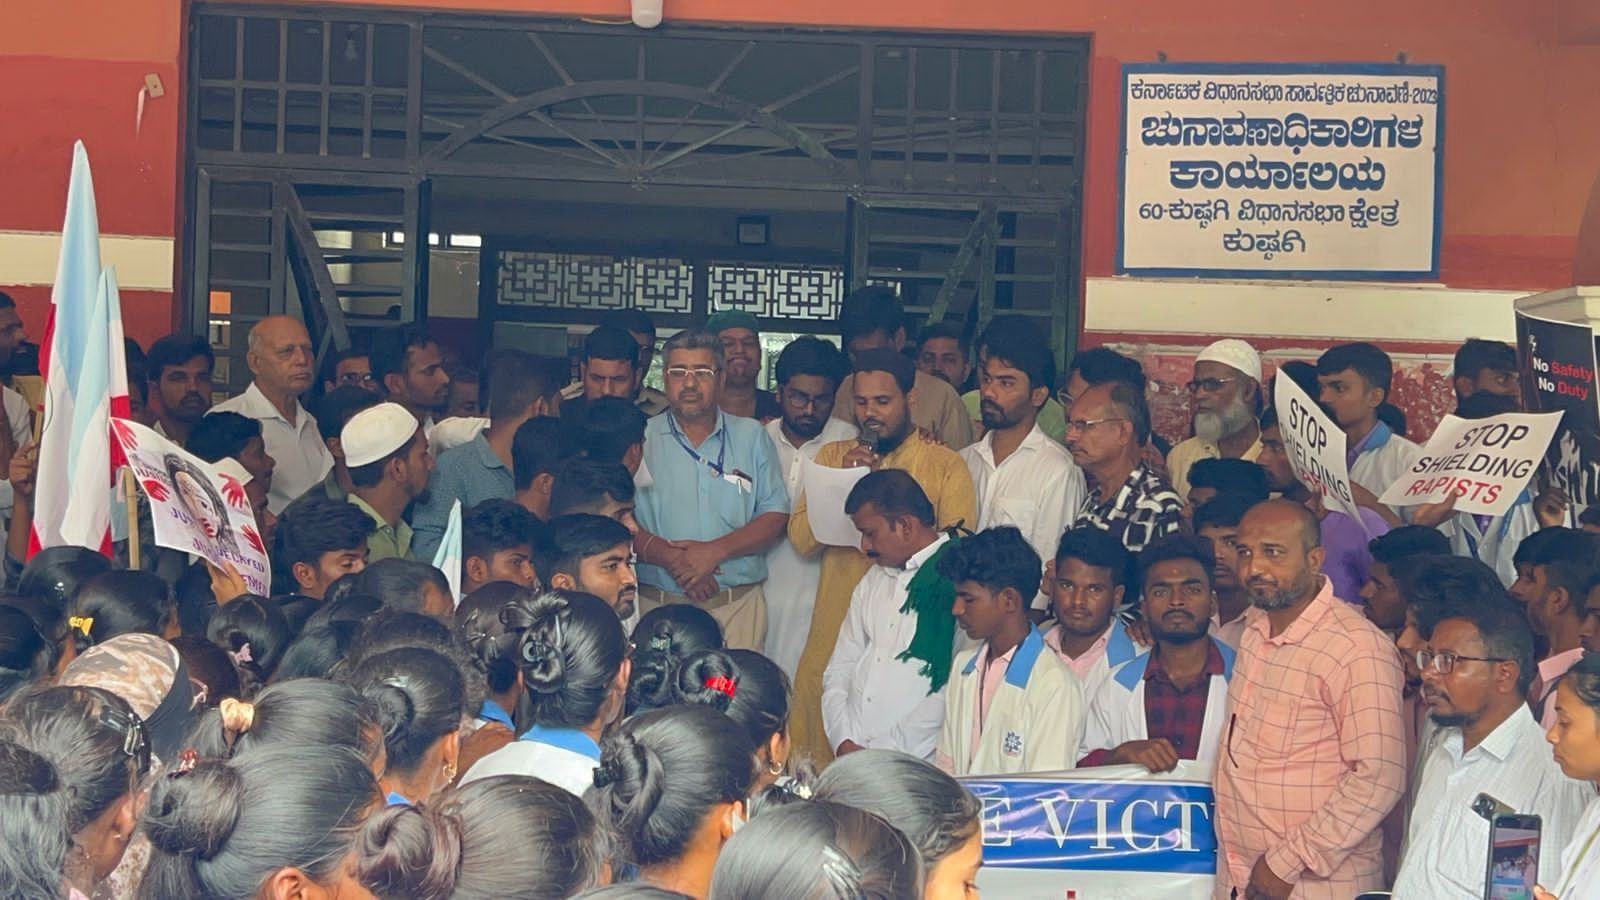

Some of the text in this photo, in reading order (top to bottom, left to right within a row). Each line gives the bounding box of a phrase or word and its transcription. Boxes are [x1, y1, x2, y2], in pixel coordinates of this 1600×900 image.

[1131, 79, 1201, 100] ಕರ್ನಾಟಕ
[1203, 81, 1283, 104] ವಿಧಾನಸಭಾ
[1285, 82, 1346, 105] ಸಾರ್ವತ್ರಿಕ
[1141, 111, 1423, 155] ಚುನಾವಣಾಧಿಕಾರಿಗಳ
[1170, 154, 1386, 191] ಕಾರ್ಯಾಲಯ
[1139, 198, 1400, 229] 60-ಕುಷ್ಟಗಿ ವಿಧಾನಸಭಾ ಕ್ಷೇತ್ರ
[1223, 228, 1306, 260] ಕುಷ್ಟಗಿ
[1533, 357, 1594, 384] No Safety
[1538, 377, 1589, 401] No Duty
[1289, 398, 1327, 455] STOP
[1455, 423, 1529, 449] STOP
[1412, 453, 1533, 479] SHIELDING
[1404, 476, 1503, 504] RAPISTS
[1035, 798, 1216, 852] VICT
